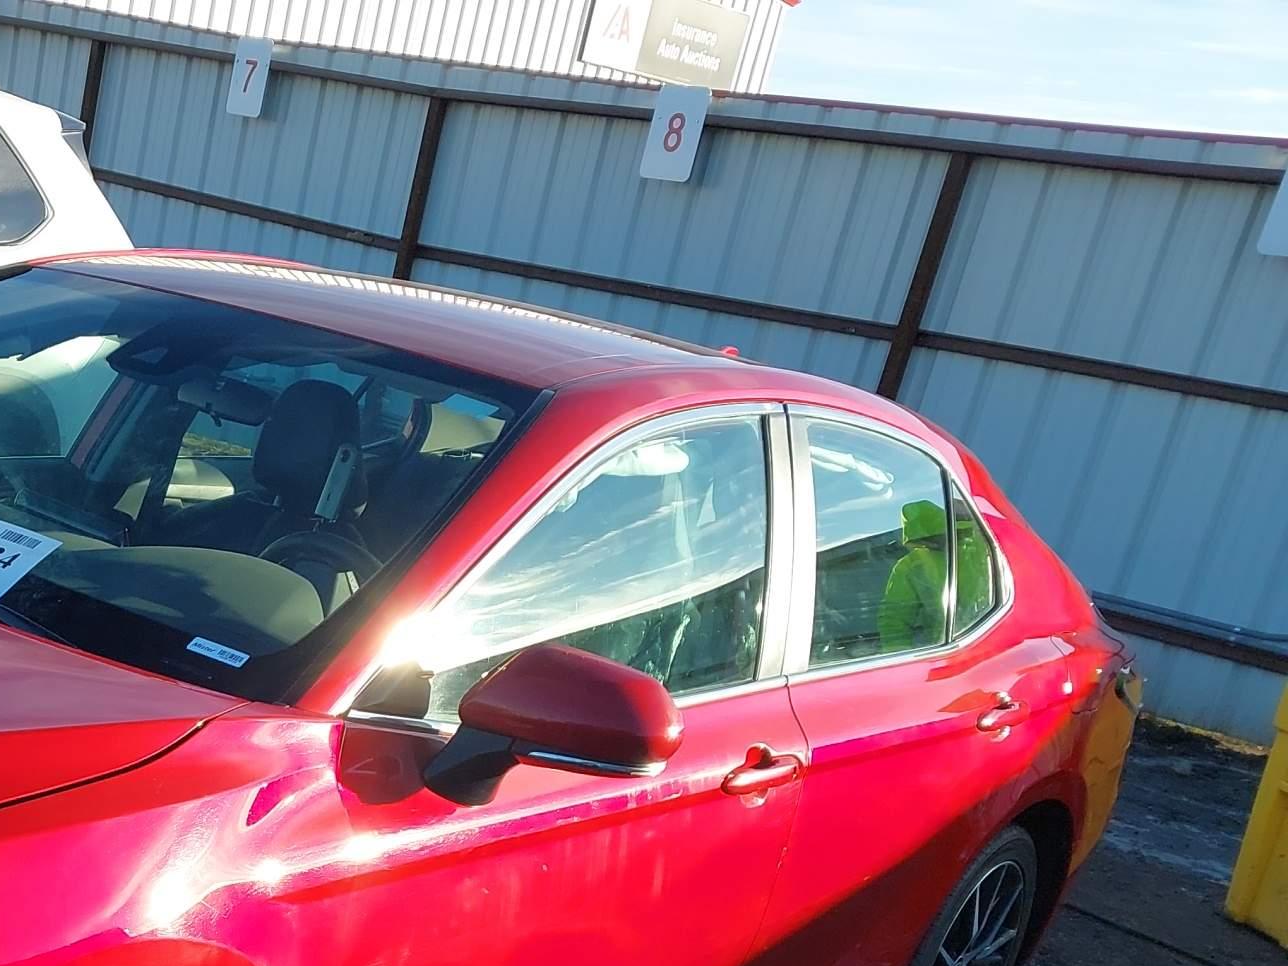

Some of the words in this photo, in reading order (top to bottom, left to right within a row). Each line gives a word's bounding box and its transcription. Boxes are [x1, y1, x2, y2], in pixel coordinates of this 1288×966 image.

[672, 17, 718, 47] Insurance
[656, 38, 681, 60] Auto
[679, 44, 721, 71] Auctions
[242, 59, 258, 93] 7
[663, 112, 686, 152] 8
